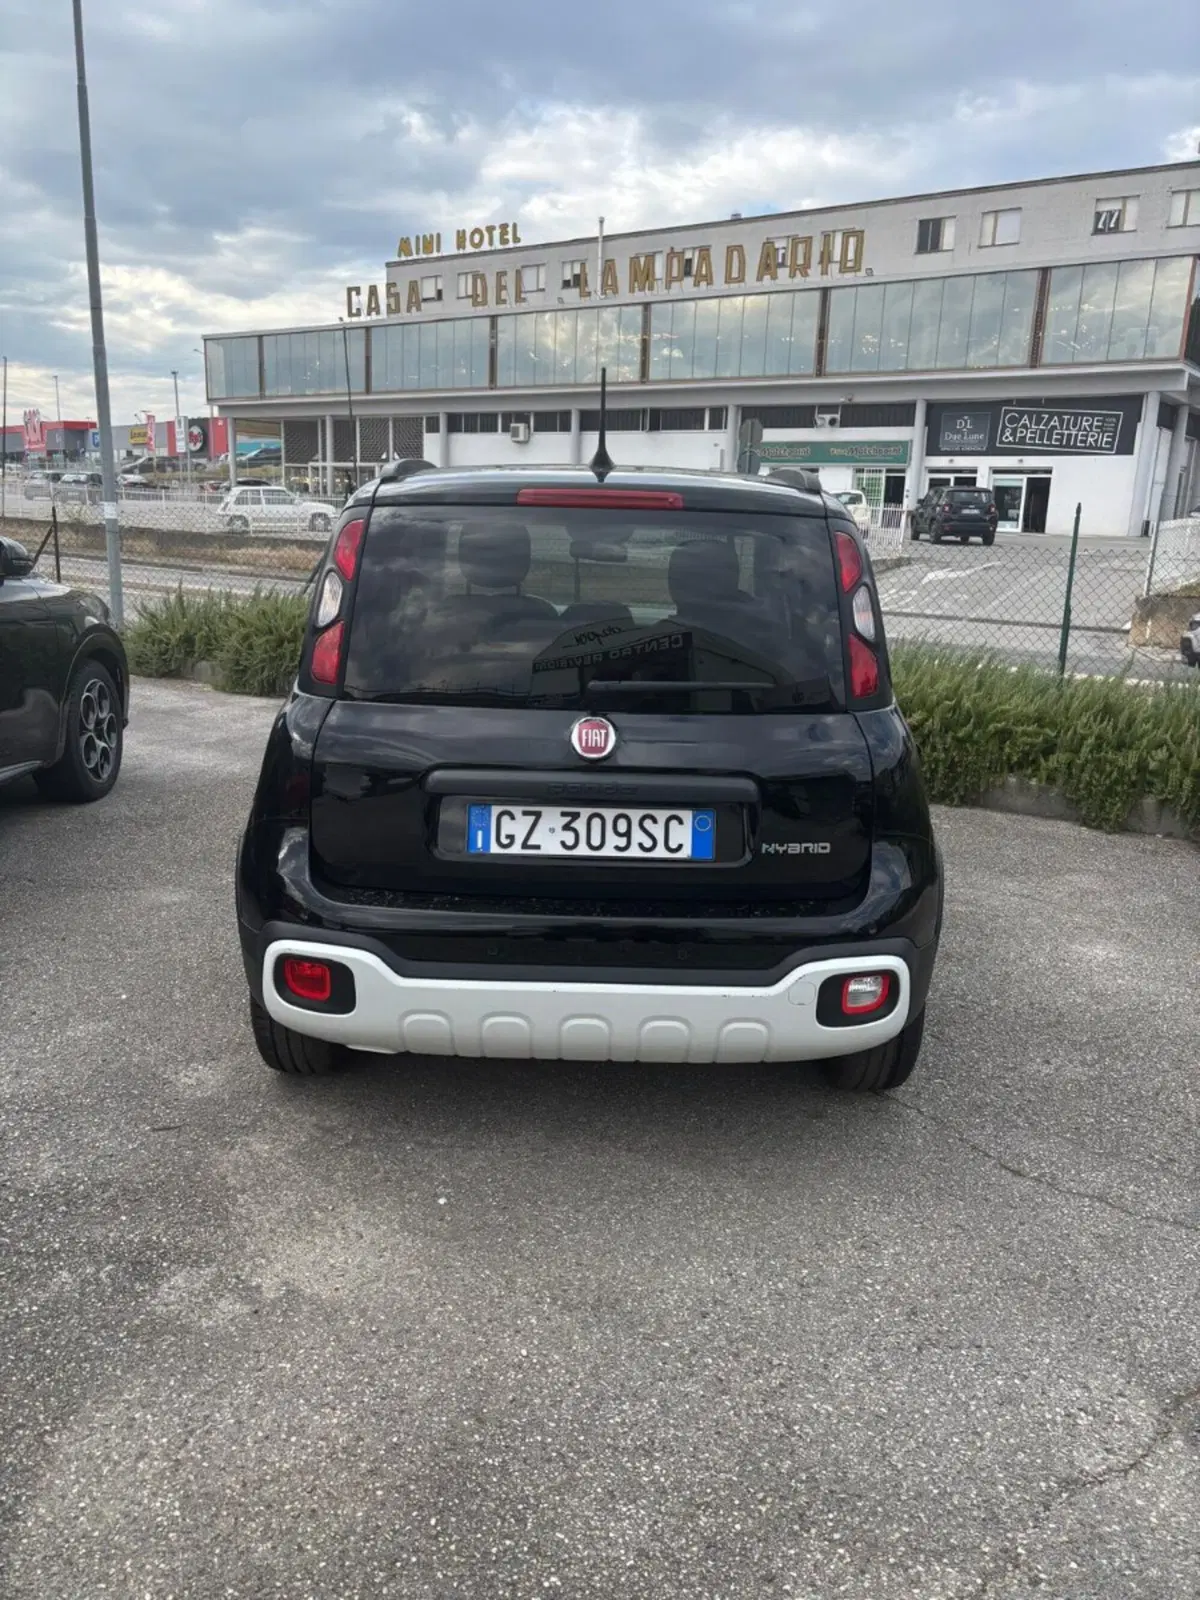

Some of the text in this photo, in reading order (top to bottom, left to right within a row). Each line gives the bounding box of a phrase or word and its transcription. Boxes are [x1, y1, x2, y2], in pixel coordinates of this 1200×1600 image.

[398, 222, 521, 257] MINI HOTEL
[347, 229, 866, 317] CASA DEL LAMPADARIO
[1004, 412, 1103, 431] CALZATURE
[582, 729, 607, 748] FIAT
[495, 810, 543, 850] GZ
[559, 811, 685, 854] 309SC
[762, 842, 831, 854] HYBRID
